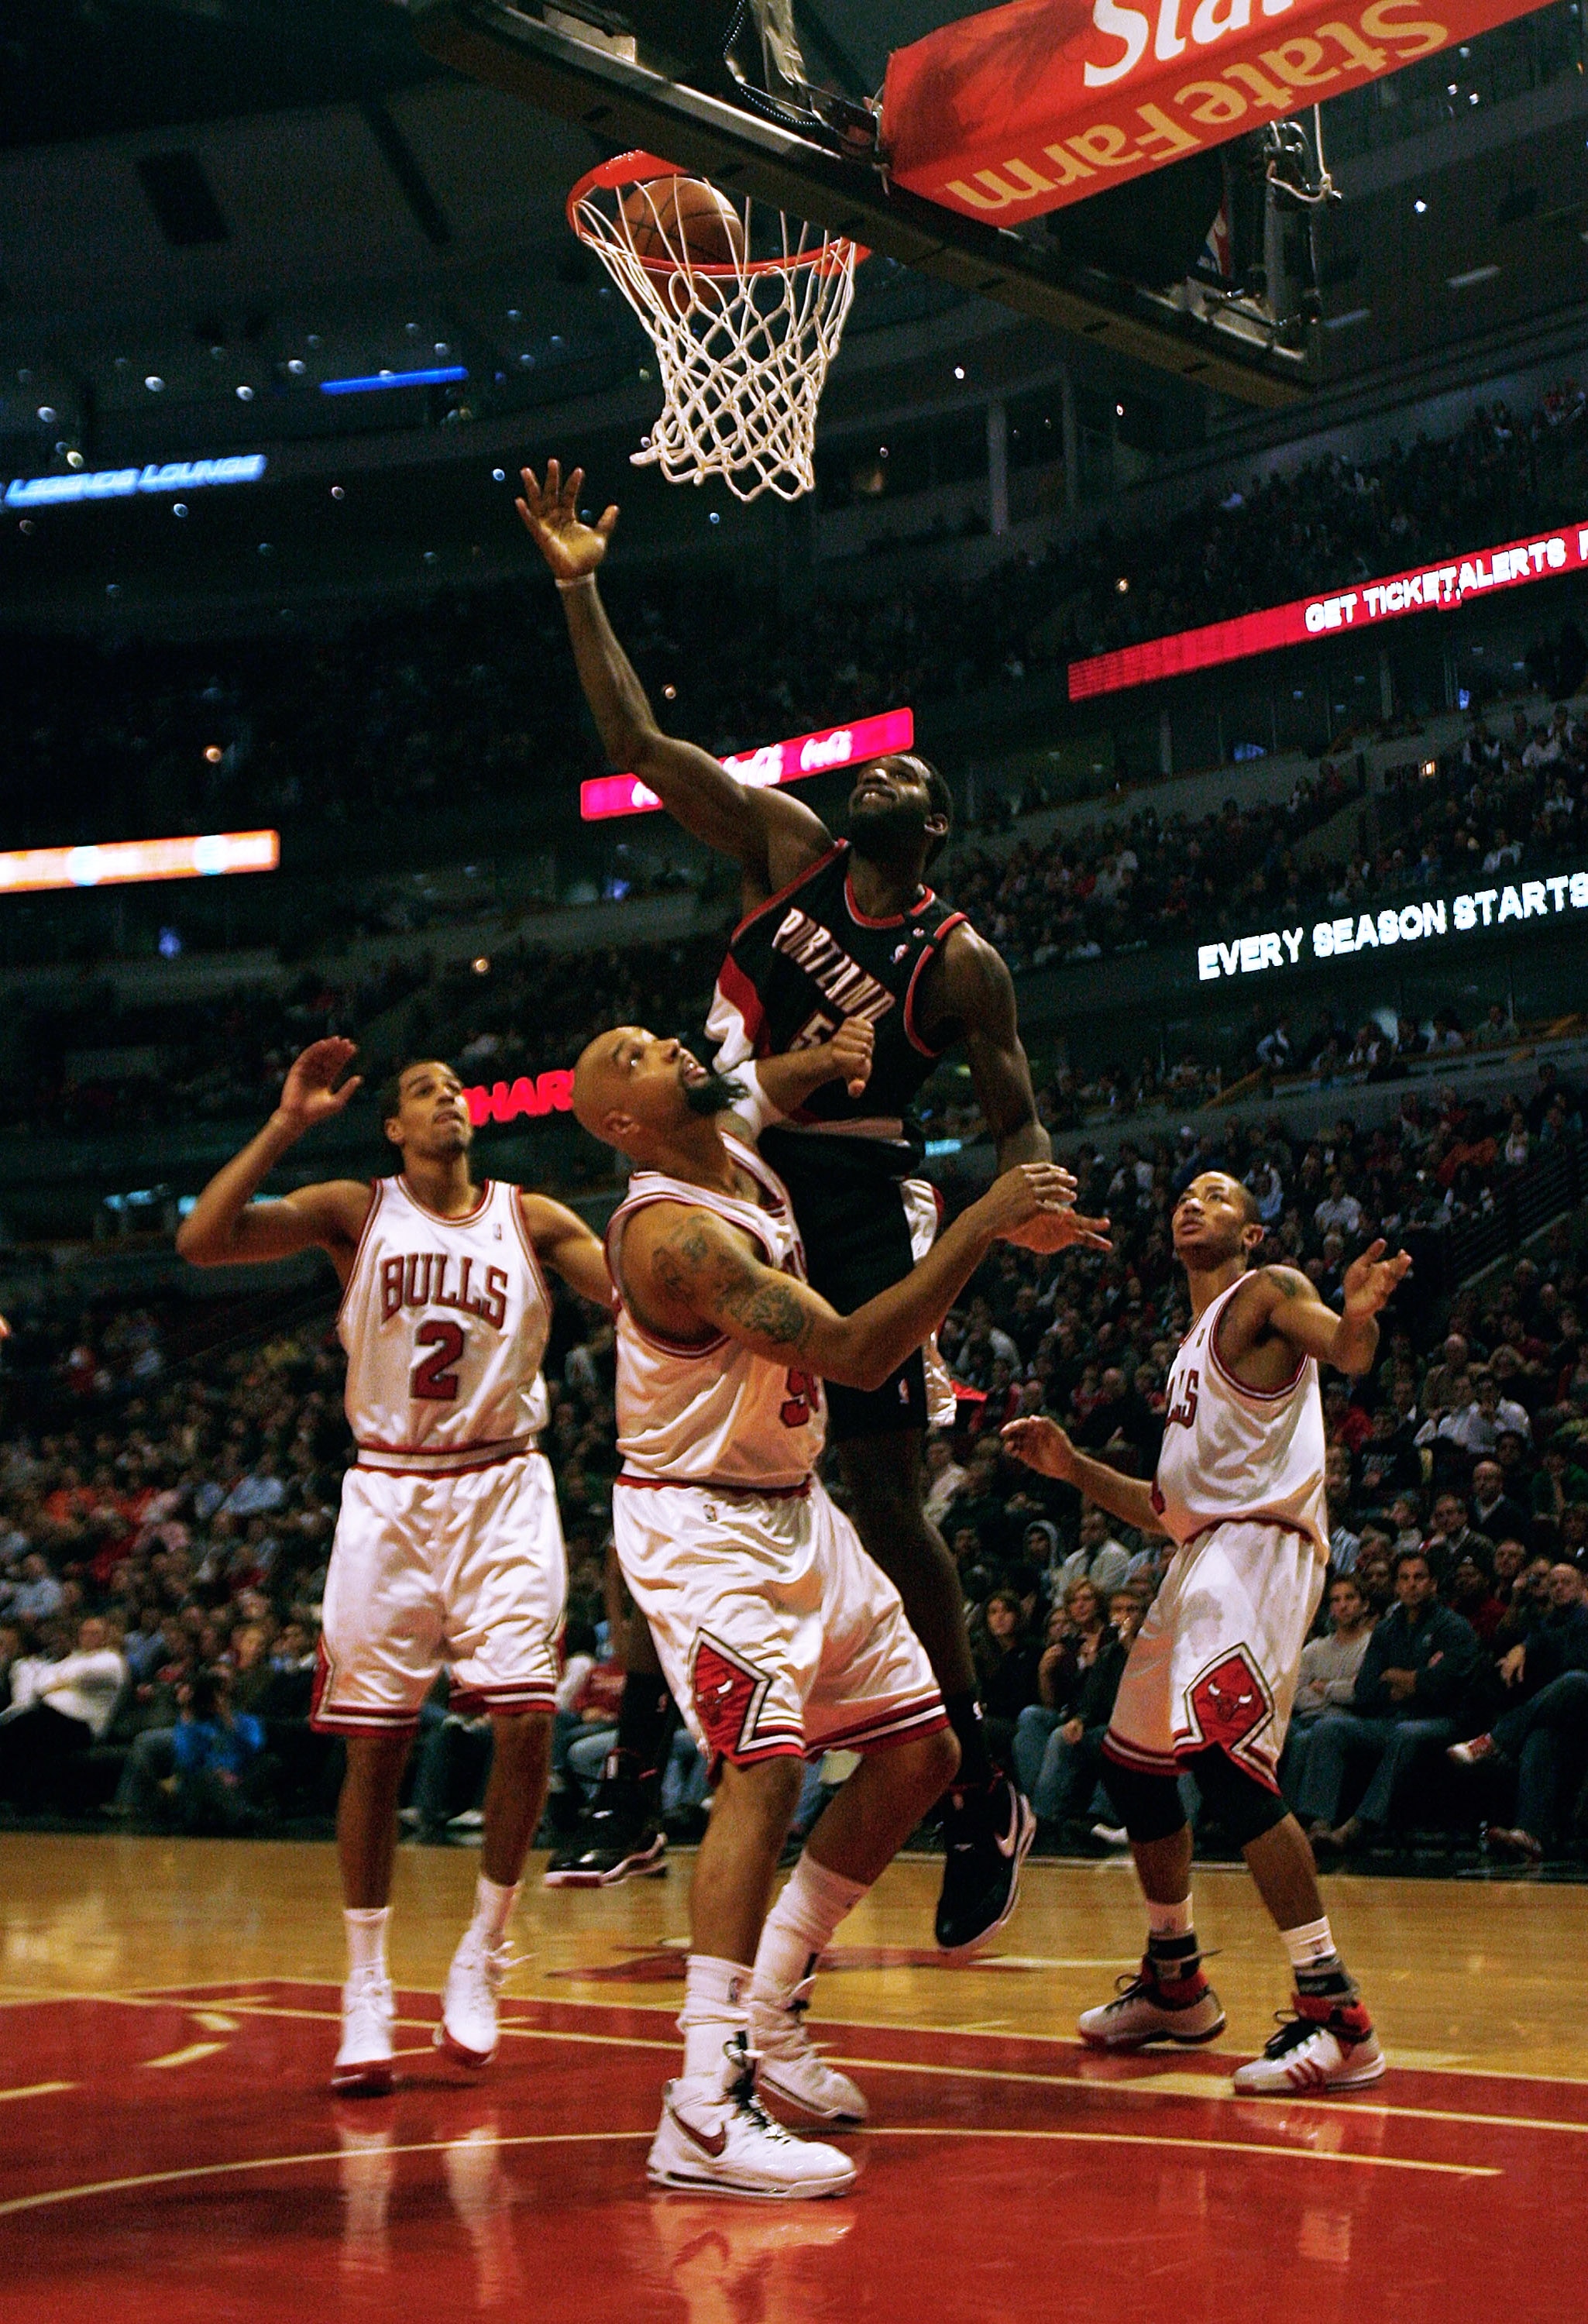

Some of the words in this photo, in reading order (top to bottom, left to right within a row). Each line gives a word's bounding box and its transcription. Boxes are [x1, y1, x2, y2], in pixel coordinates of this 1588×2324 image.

[1084, 0, 1298, 87] Sta
[1305, 593, 1357, 632] GET
[772, 907, 896, 1022] PORTLAND
[1198, 927, 1303, 981] EVERY
[1314, 900, 1447, 957] SEASON
[1453, 872, 1588, 930] STARTS
[462, 1067, 575, 1128] HAR
[380, 1253, 508, 1330] BULLS
[409, 1320, 464, 1400] 2
